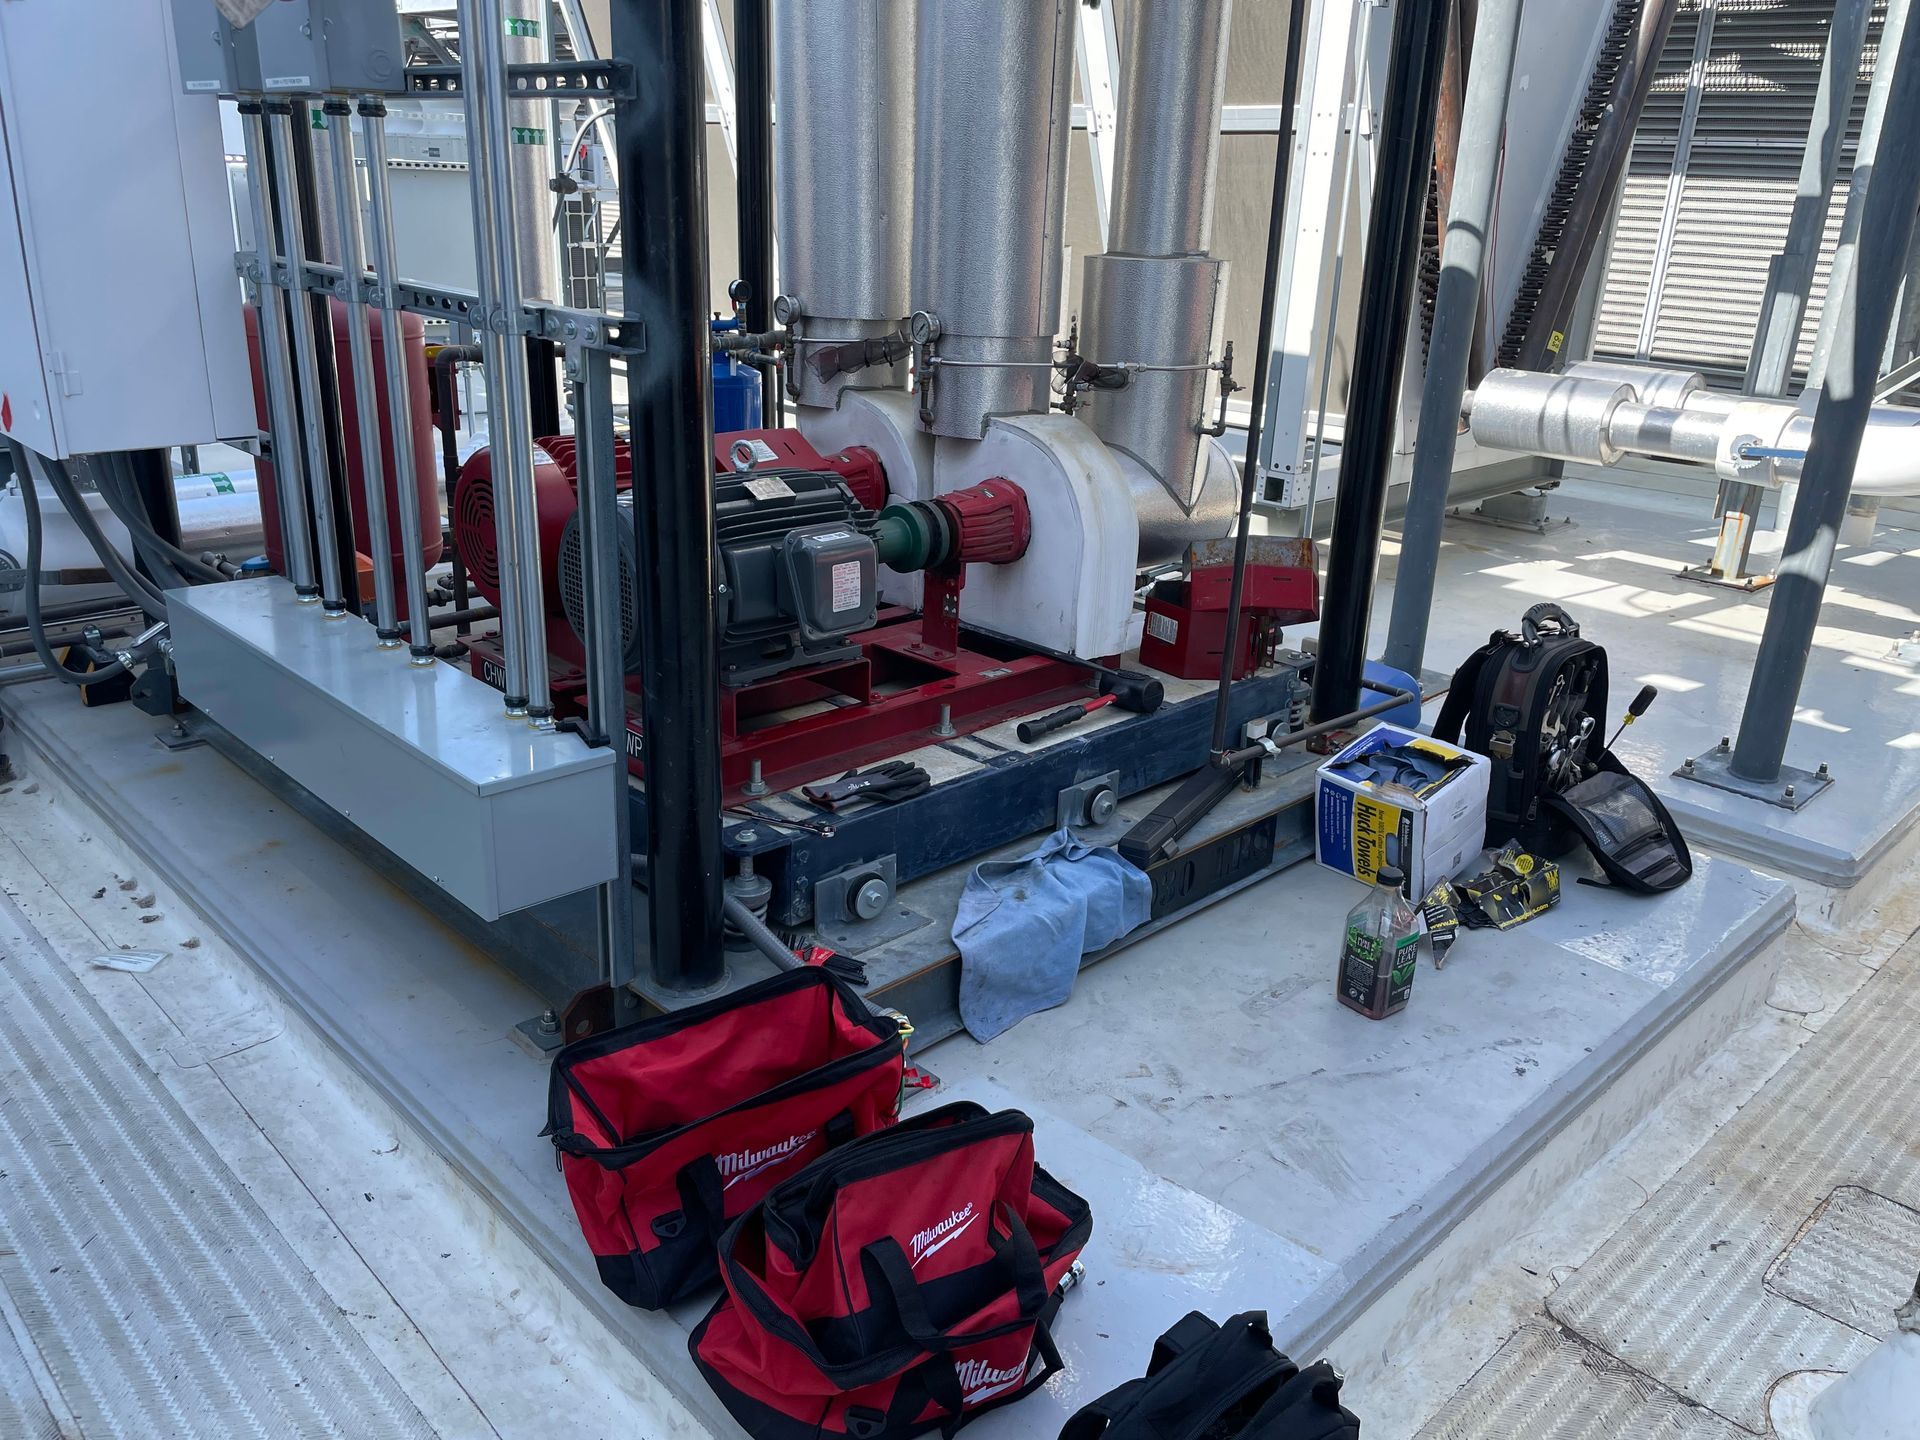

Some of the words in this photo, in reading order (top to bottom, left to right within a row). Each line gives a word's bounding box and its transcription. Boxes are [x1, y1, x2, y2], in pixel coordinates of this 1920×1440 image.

[1357, 802, 1377, 836] Huck
[1357, 834, 1377, 878] Towels
[1396, 951, 1416, 966] LEAF
[1398, 942, 1417, 957] PURE
[715, 1129, 816, 1177] Milwaukee
[909, 1204, 971, 1258] Milwaukee
